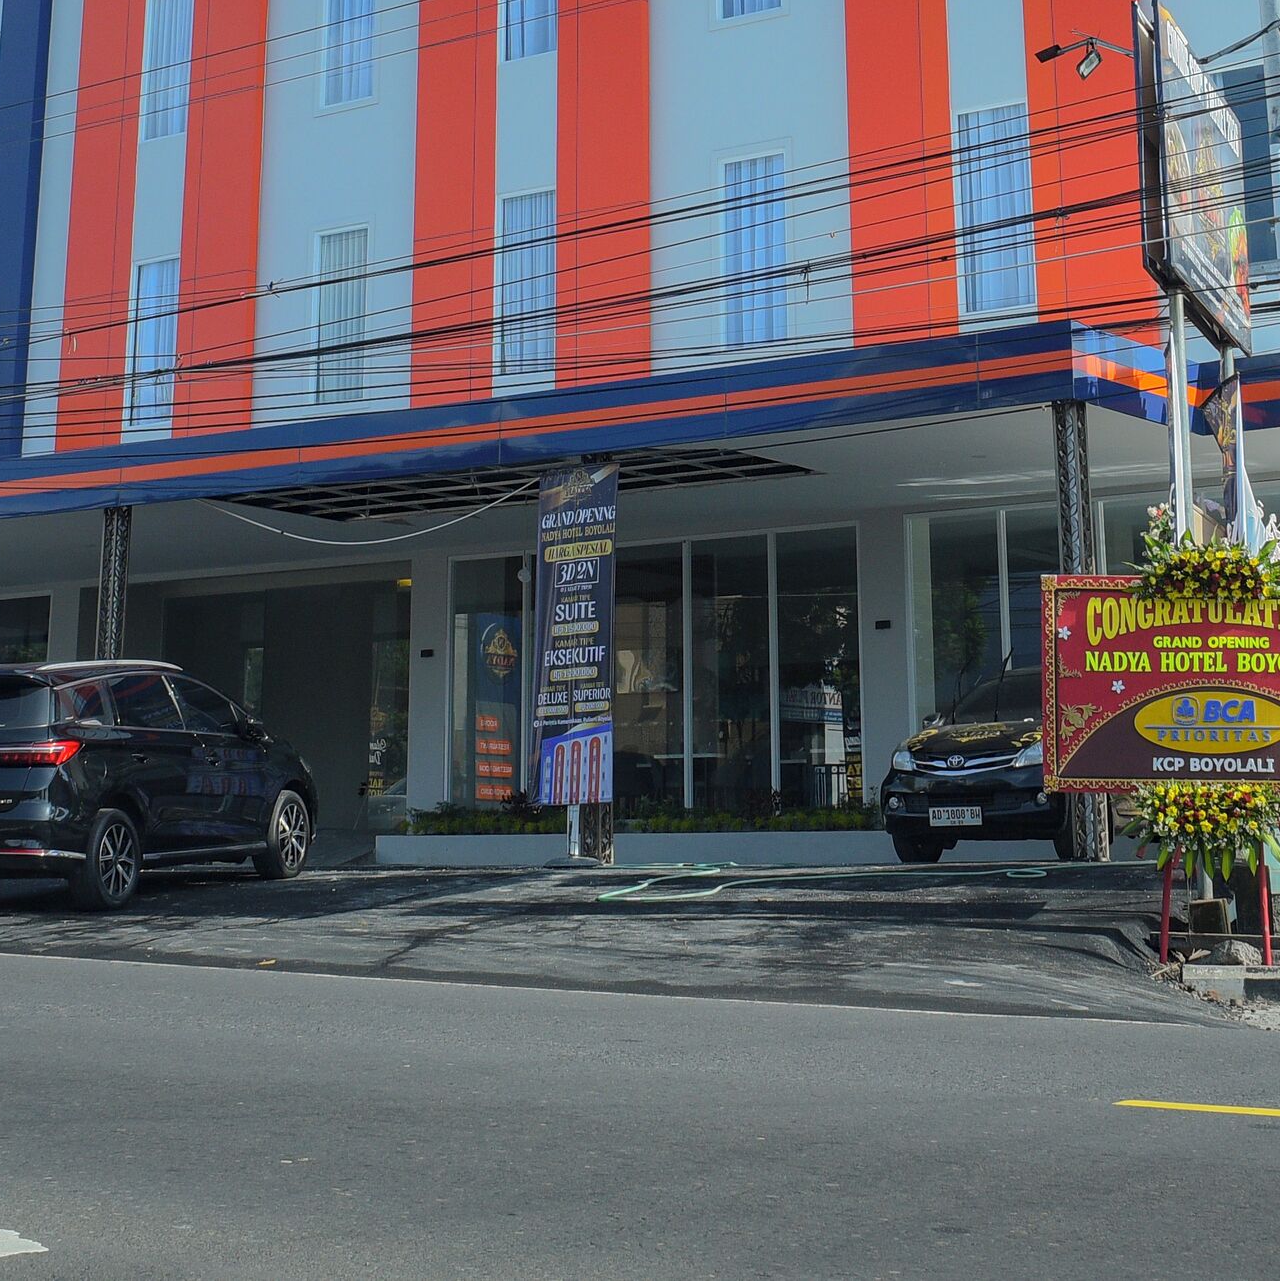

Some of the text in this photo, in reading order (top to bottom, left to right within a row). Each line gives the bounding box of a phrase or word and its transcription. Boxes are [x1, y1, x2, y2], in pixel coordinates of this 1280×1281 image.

[541, 505, 616, 529] GRAND OPENING
[558, 561, 596, 584] 3D 2N
[555, 601, 596, 622] SUITE
[1153, 635, 1270, 649] GRAND OPENING
[544, 646, 606, 667] EKSEKUTIF
[1085, 651, 1152, 673] NADYA
[1160, 651, 1228, 673] HOTEL
[538, 692, 568, 706] DELUXE
[573, 688, 611, 702] SUPERIOR
[1201, 699, 1257, 724] BCA
[1156, 729, 1272, 743] PRIORITAS
[1152, 757, 1275, 774] KCP BOYOLALI
[932, 809, 943, 820] AD
